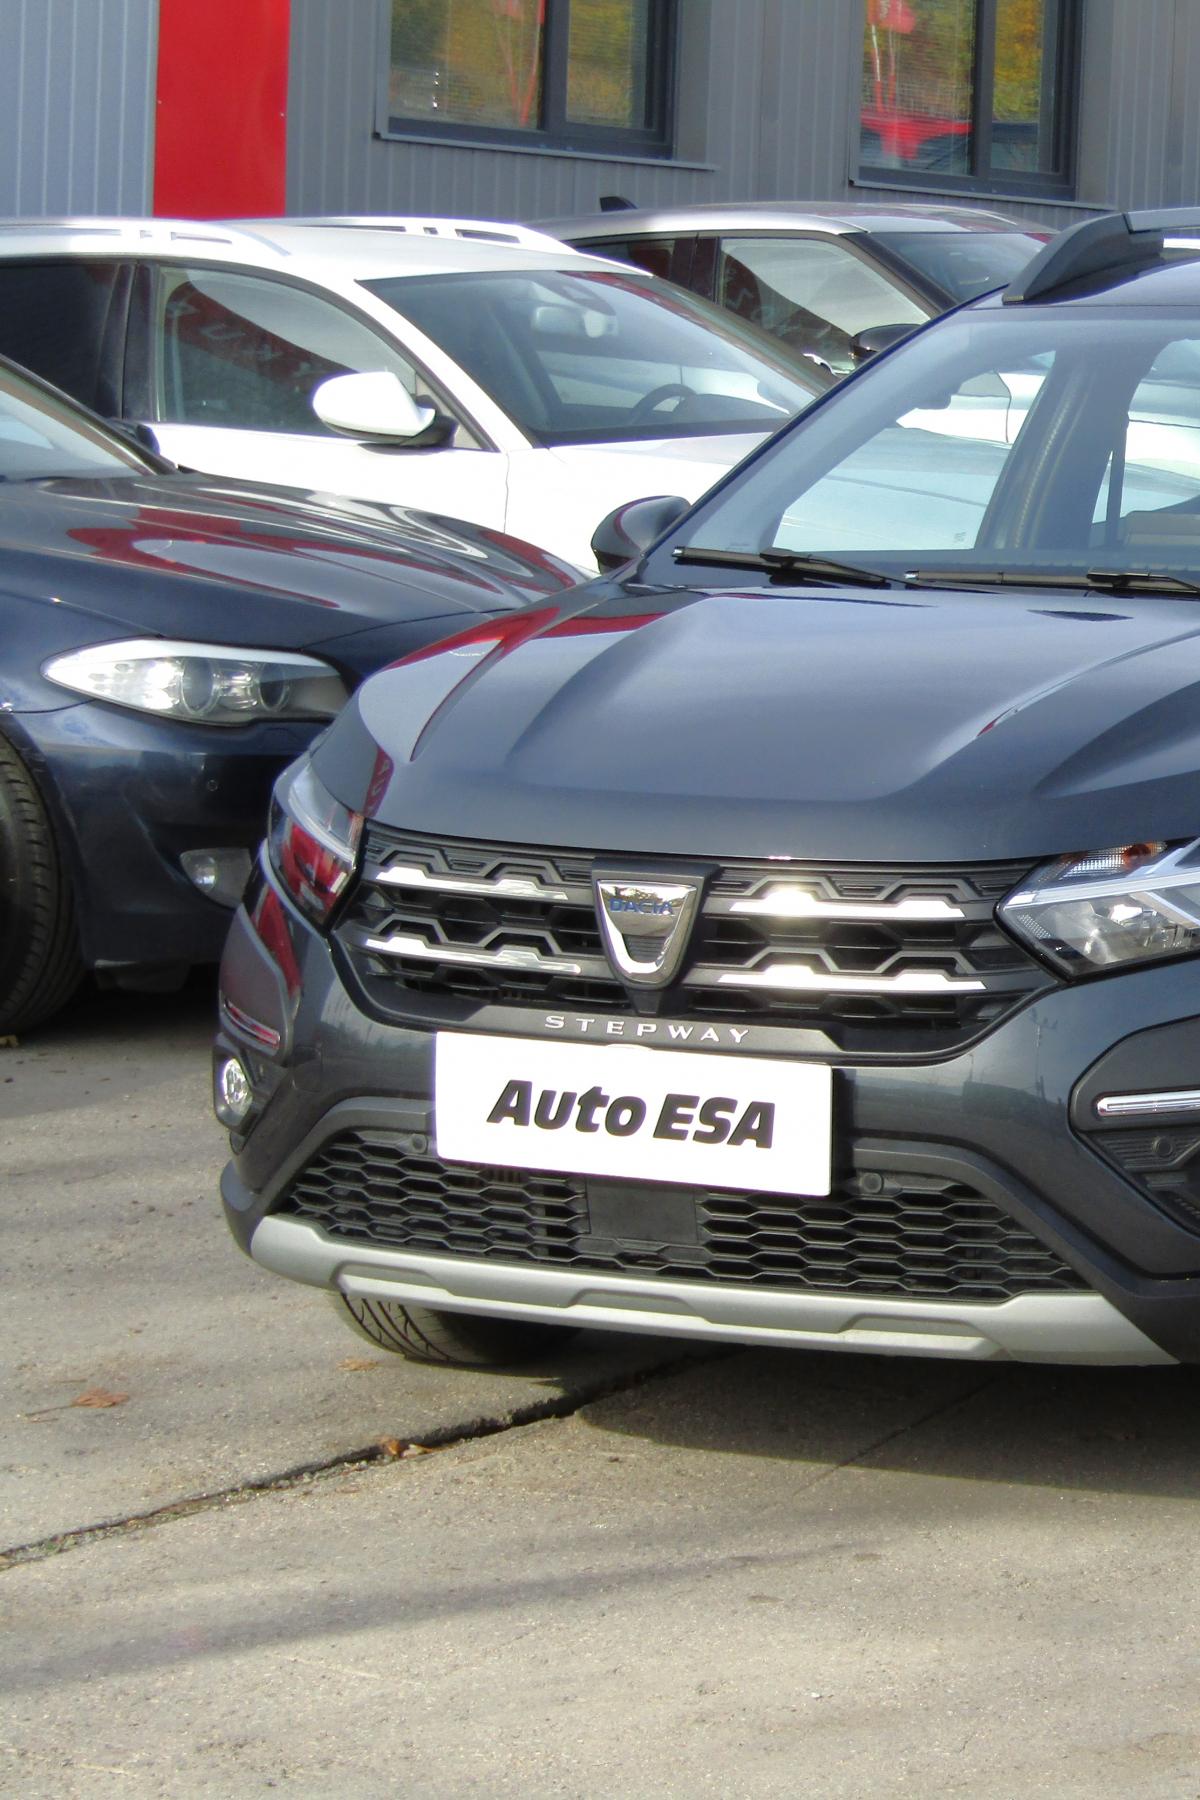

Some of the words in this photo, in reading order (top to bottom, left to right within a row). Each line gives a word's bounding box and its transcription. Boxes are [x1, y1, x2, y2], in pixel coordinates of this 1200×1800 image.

[609, 898, 674, 915] DACIA
[544, 1015, 750, 1044] STEPWAY
[485, 1079, 647, 1137] Auto
[652, 1093, 776, 1149] ESA
